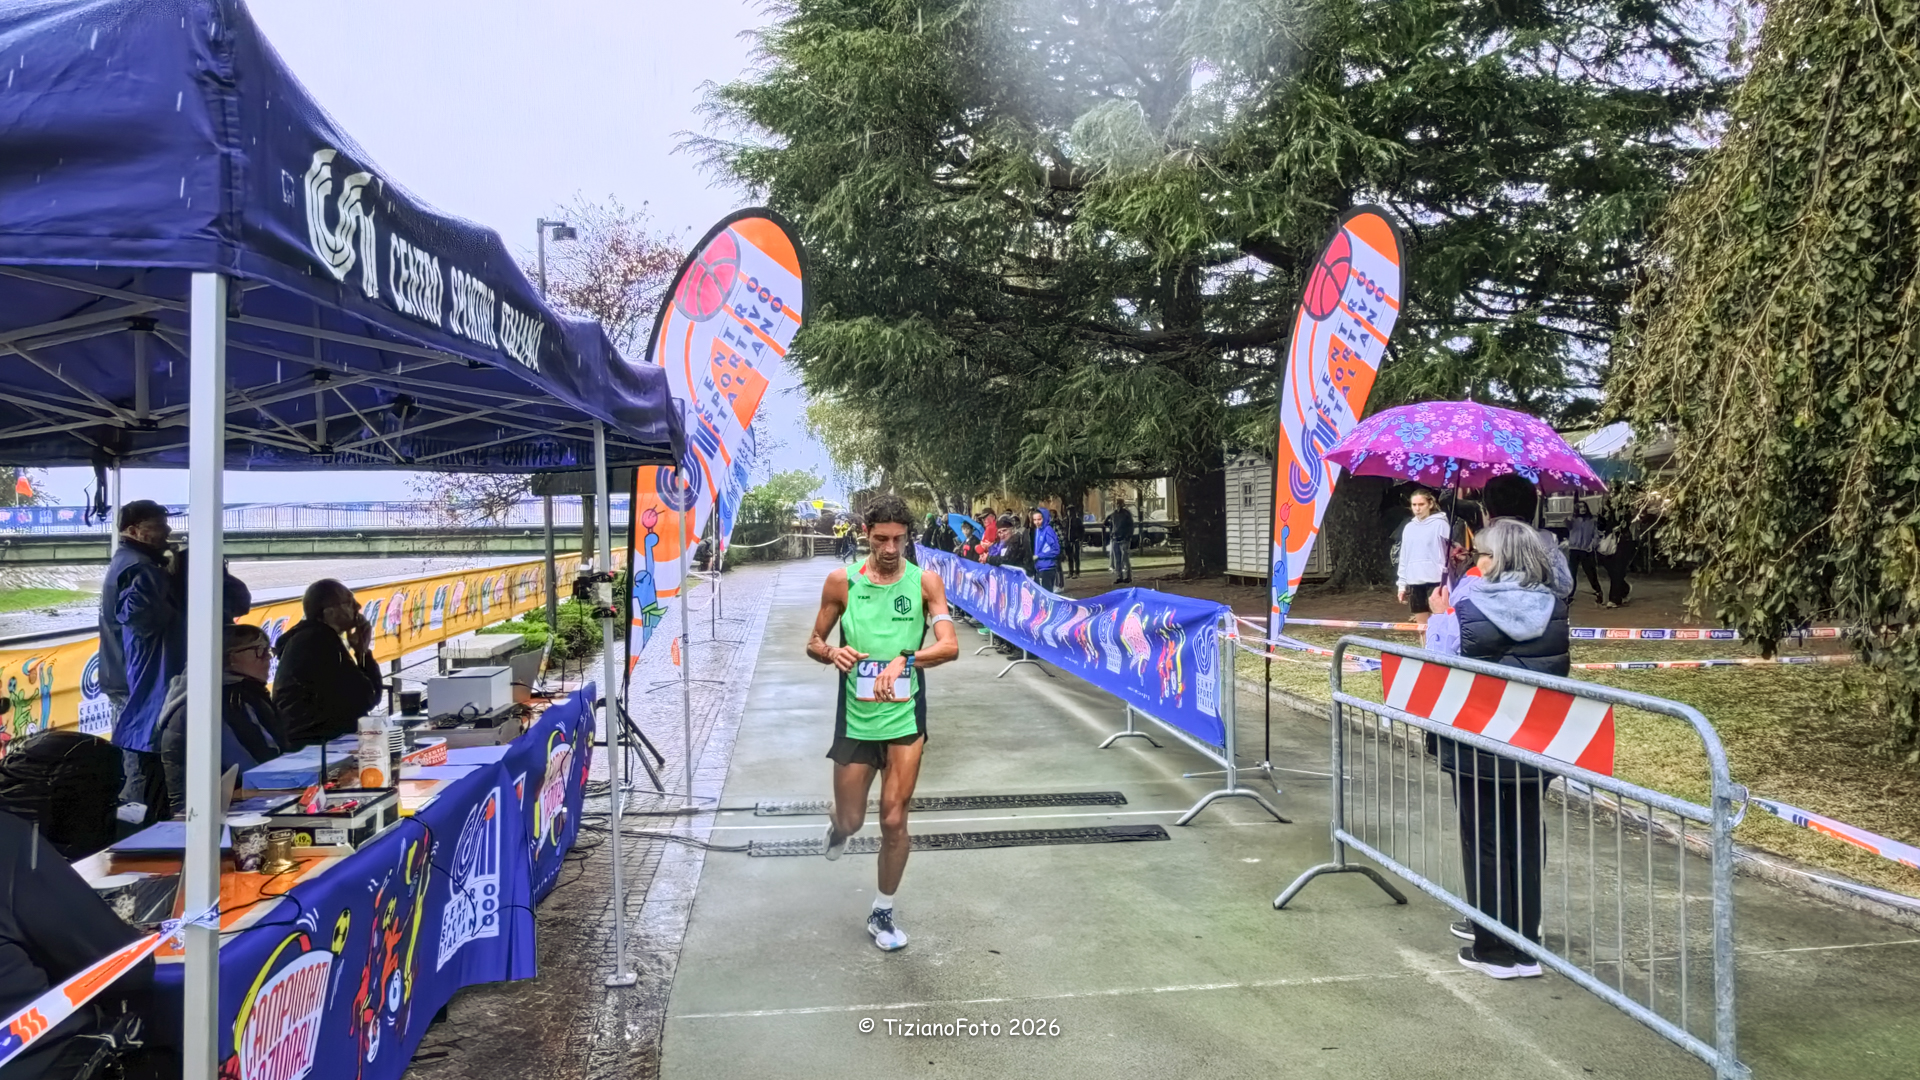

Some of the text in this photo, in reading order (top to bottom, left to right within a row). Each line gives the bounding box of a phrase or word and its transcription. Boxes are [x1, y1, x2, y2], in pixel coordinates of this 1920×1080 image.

[390, 232, 443, 327] CENTRO
[80, 720, 109, 733] ITALIA
[245, 961, 329, 1080] CAMPIONATI
[252, 1017, 318, 1080] ZIONALI
